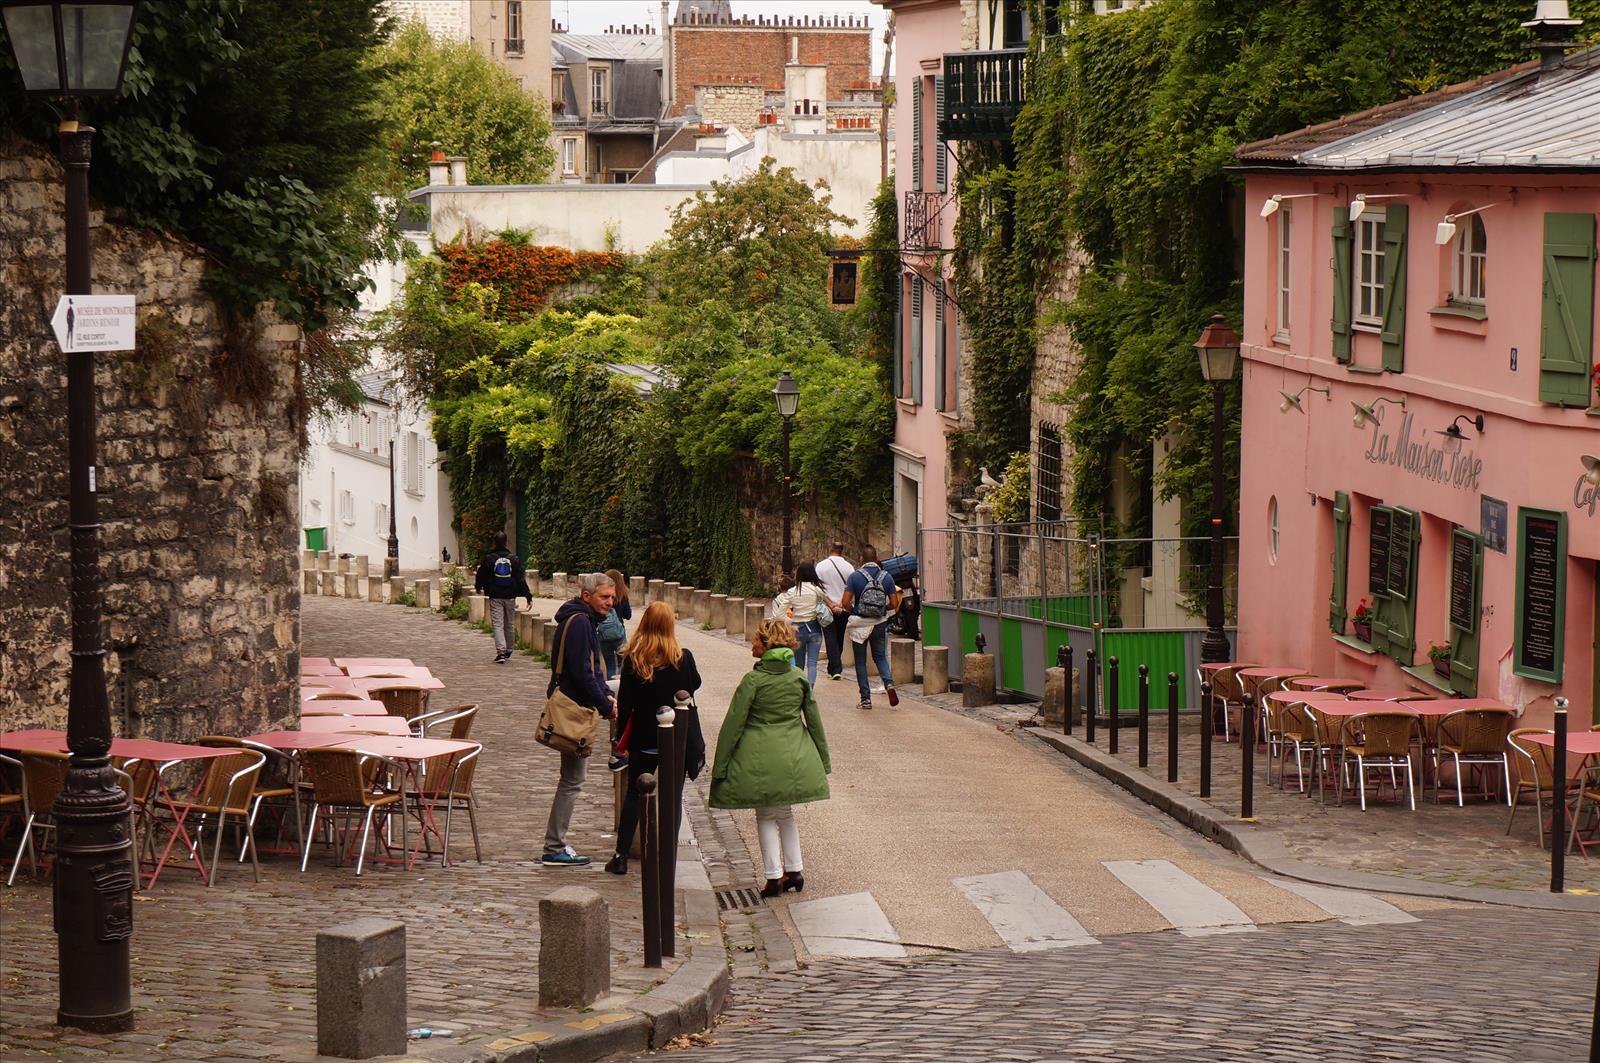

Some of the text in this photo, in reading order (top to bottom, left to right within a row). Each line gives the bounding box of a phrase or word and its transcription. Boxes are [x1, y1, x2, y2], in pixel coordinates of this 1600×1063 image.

[1365, 405, 1483, 491] La Maison Rose
